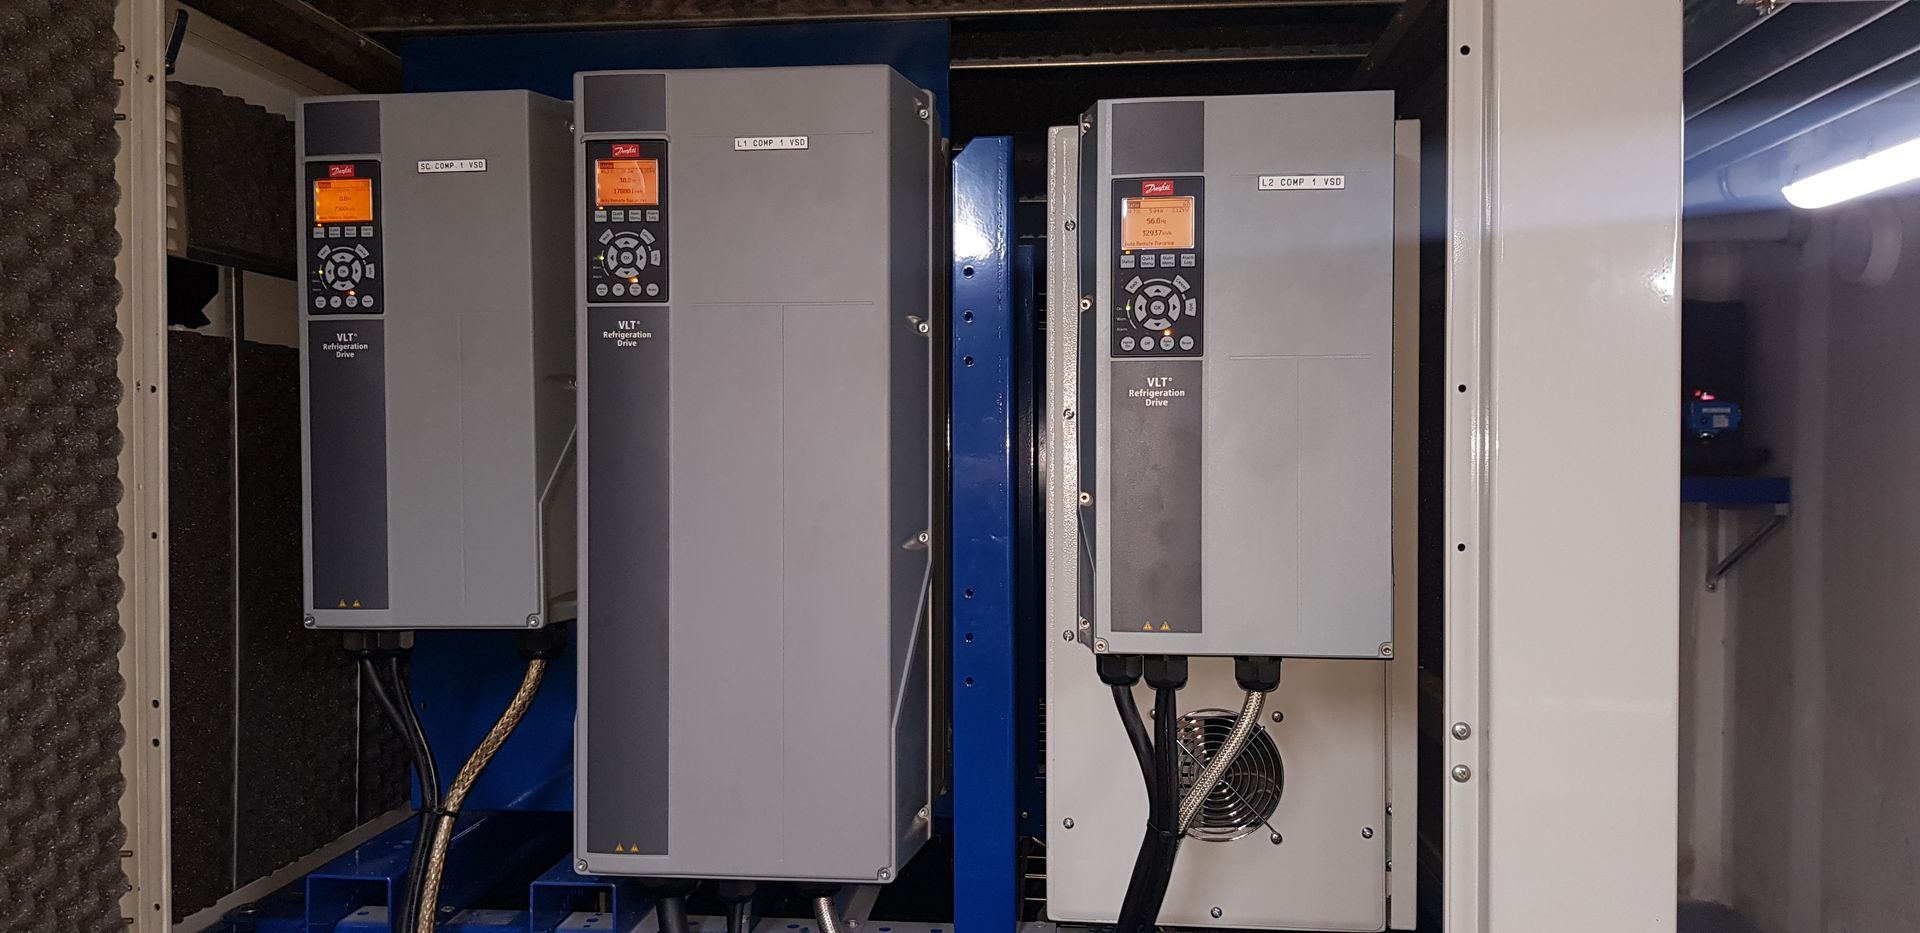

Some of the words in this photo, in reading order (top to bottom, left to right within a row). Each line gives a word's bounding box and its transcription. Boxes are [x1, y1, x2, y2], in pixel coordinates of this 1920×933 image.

[737, 139, 747, 147] L1
[752, 139, 774, 147] COMP
[789, 138, 805, 146] VSD
[420, 162, 431, 170] SC
[434, 161, 455, 170] COMP
[468, 161, 484, 169] VSD
[1262, 178, 1274, 187] L2
[1280, 178, 1305, 186] COMP
[1323, 177, 1342, 186] VSD
[603, 331, 652, 340] Refrigeration
[322, 343, 369, 351] Refrigeration
[617, 339, 638, 347] Drive
[1128, 388, 1185, 398] Refrigeration
[1145, 398, 1169, 407] Drive
